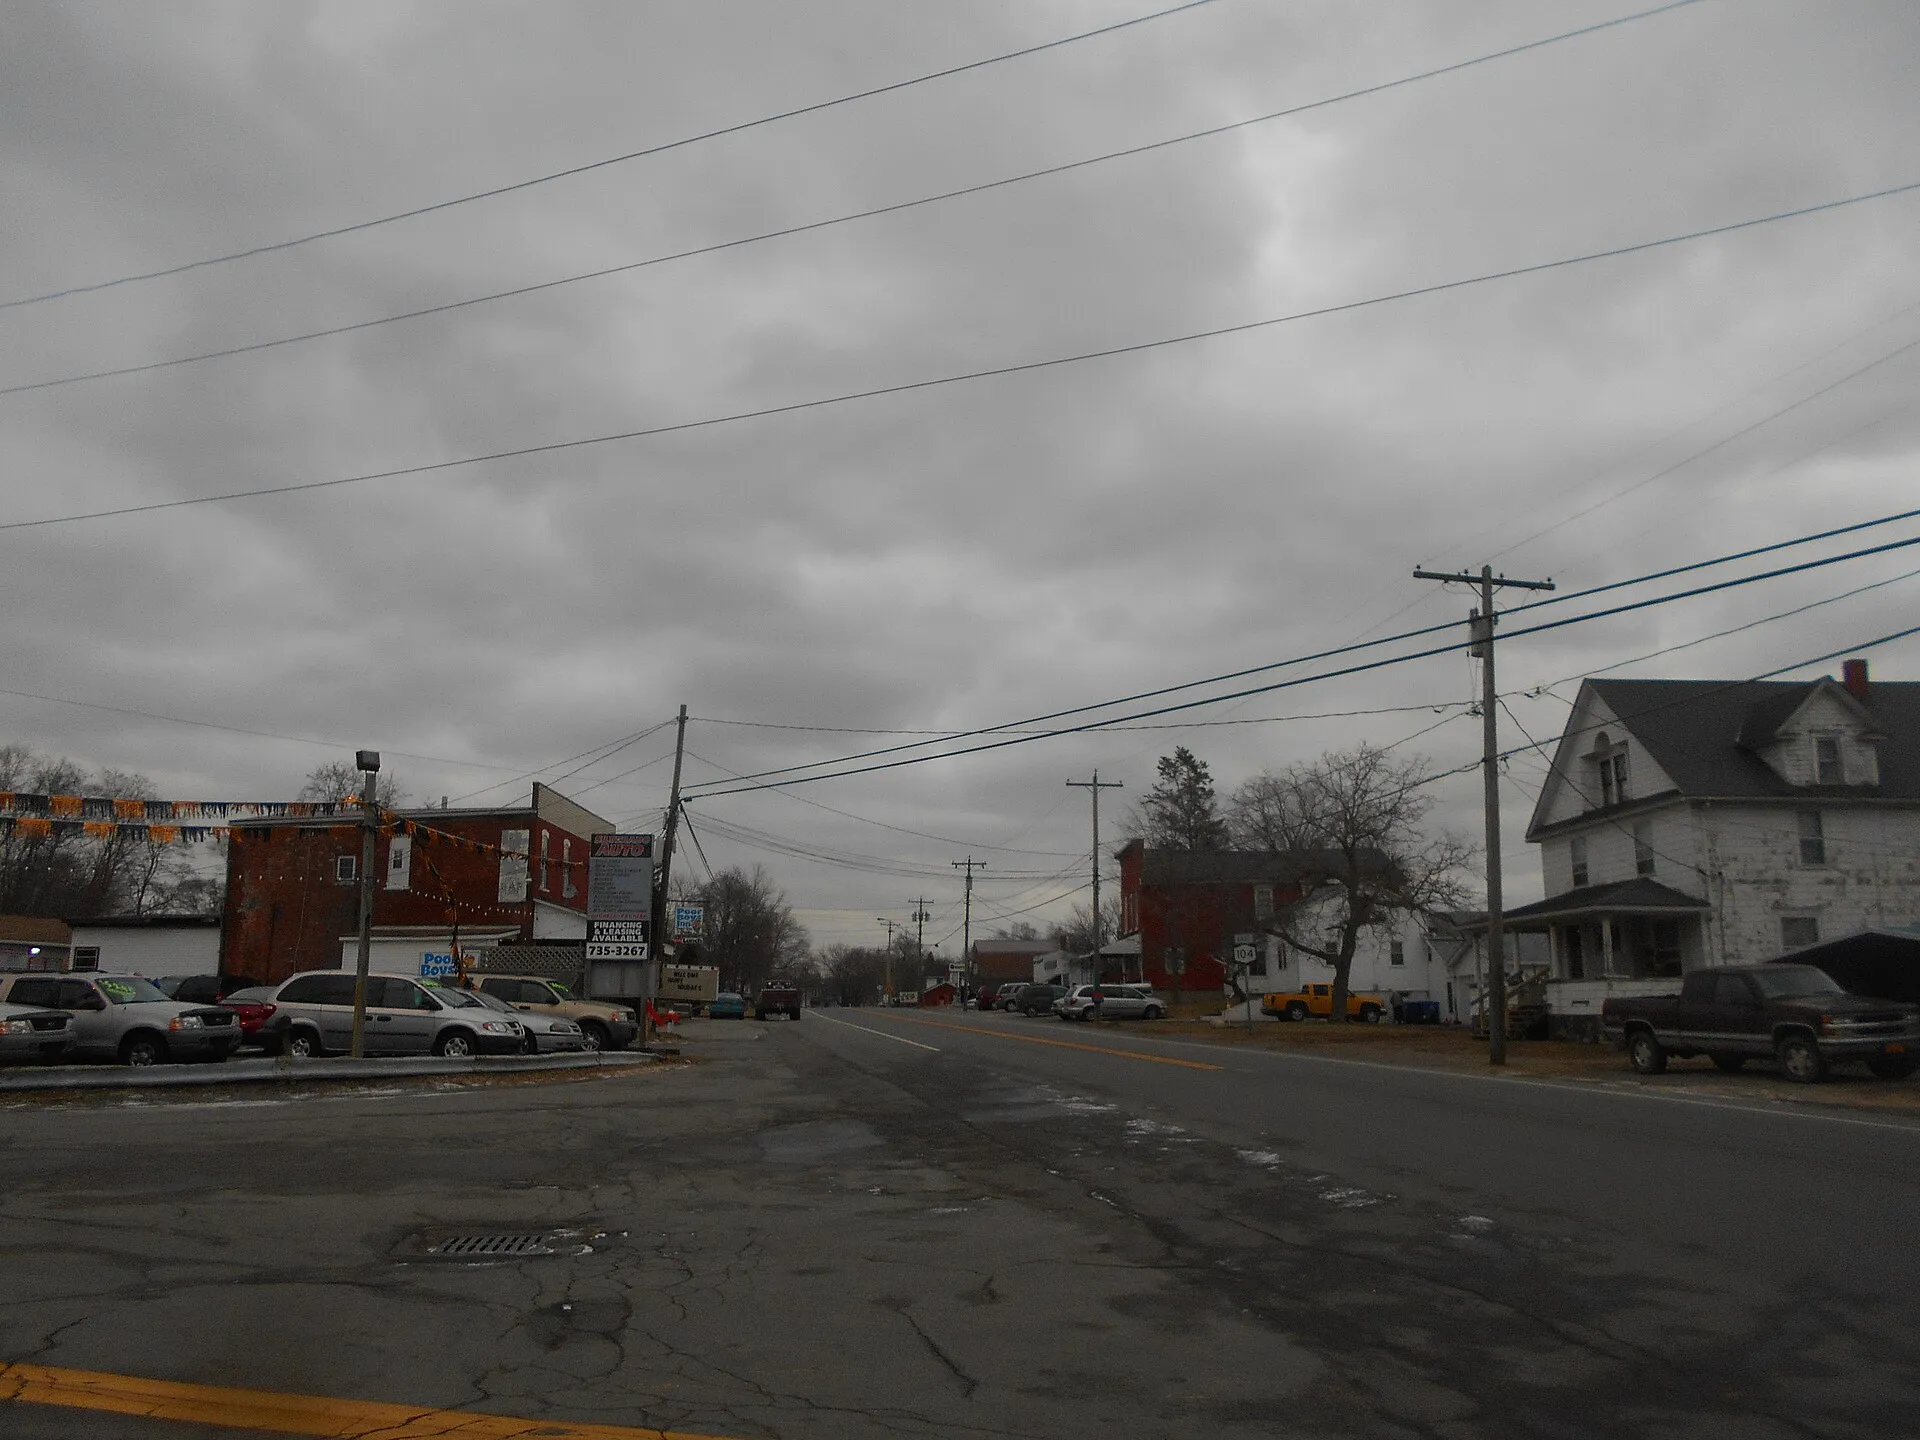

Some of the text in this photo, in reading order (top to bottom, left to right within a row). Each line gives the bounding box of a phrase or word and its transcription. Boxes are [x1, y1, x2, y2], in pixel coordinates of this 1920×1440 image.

[595, 844, 644, 857] AUTO
[594, 921, 642, 929] FINANCING
[588, 946, 645, 956] 735-3267
[1236, 949, 1253, 959] 104
[424, 953, 455, 964] Poo
